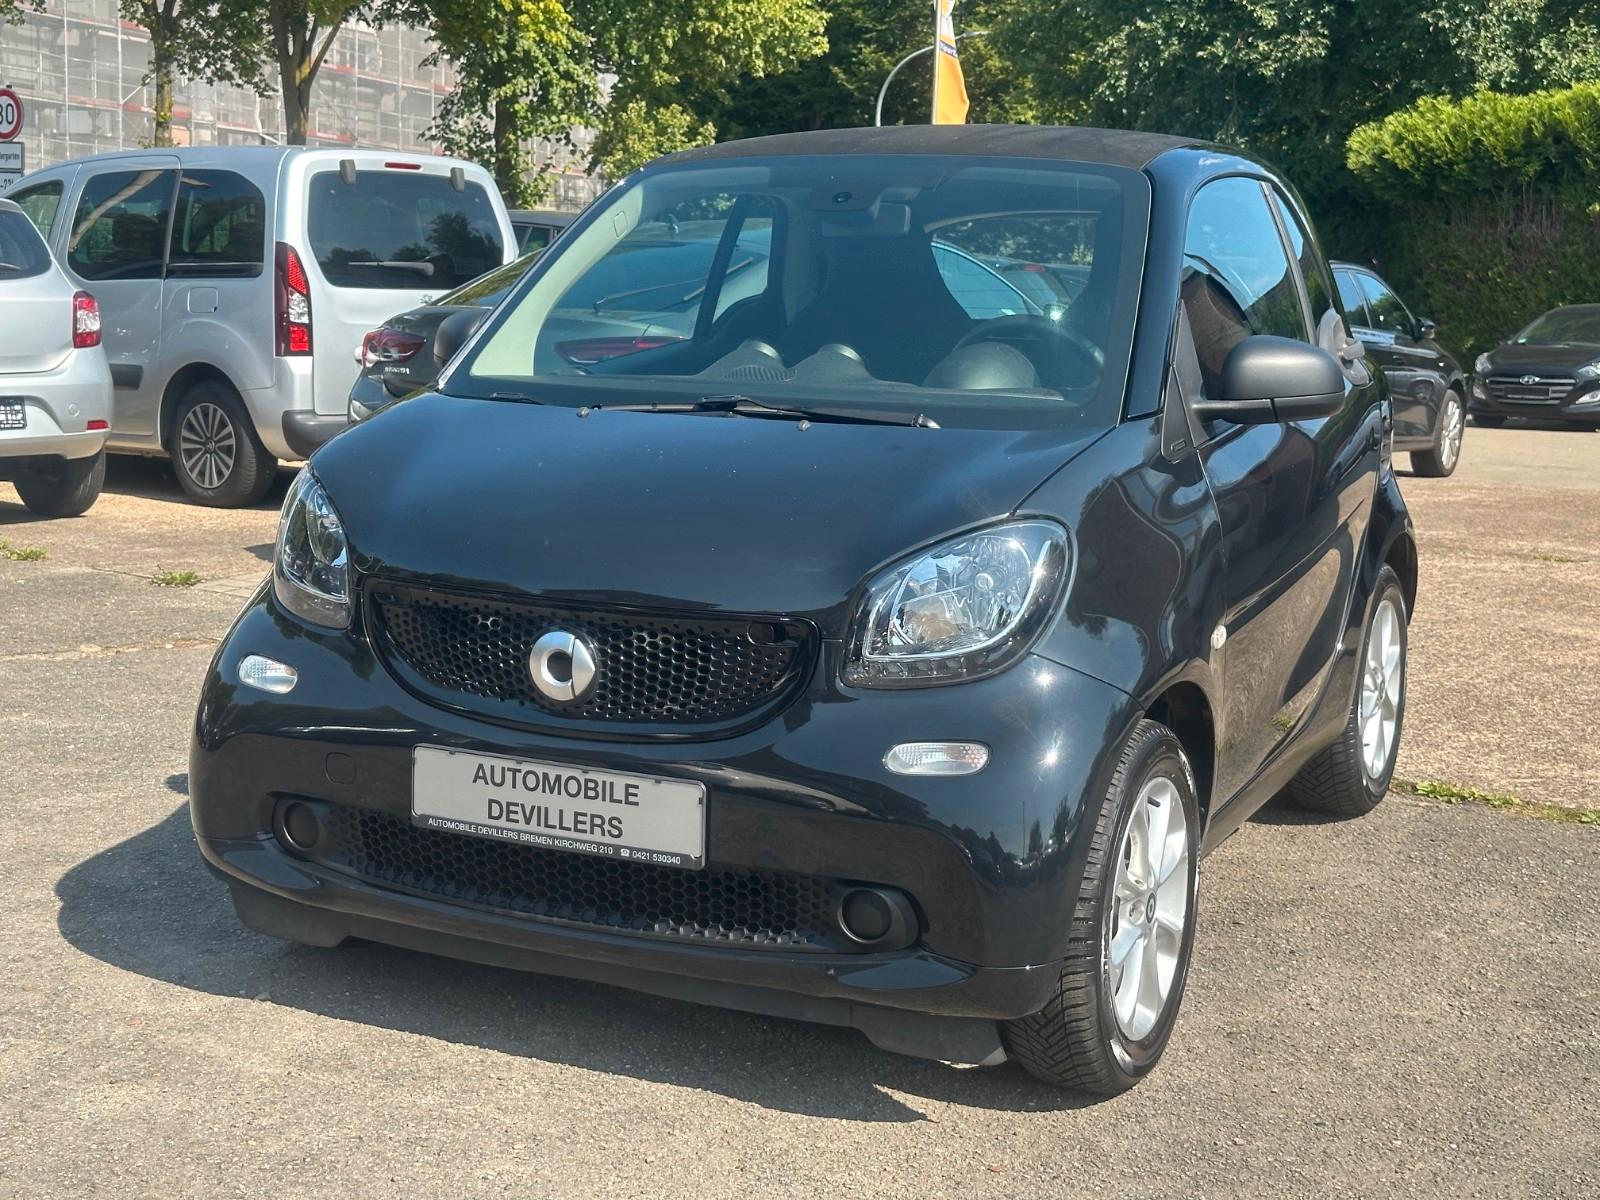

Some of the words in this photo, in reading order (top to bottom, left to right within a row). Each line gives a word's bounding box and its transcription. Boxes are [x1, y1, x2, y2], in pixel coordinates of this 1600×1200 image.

[472, 763, 640, 807] AUTOMOBILE
[487, 798, 624, 839] DEVILLERS
[428, 818, 476, 833] AUTOMOBILE
[478, 826, 518, 840] DEVILLERS
[520, 833, 552, 845] BREMEN
[554, 839, 598, 852] KIRCHWEG
[599, 845, 613, 855] 210
[632, 850, 650, 860] 0421
[652, 853, 681, 864] 530340
